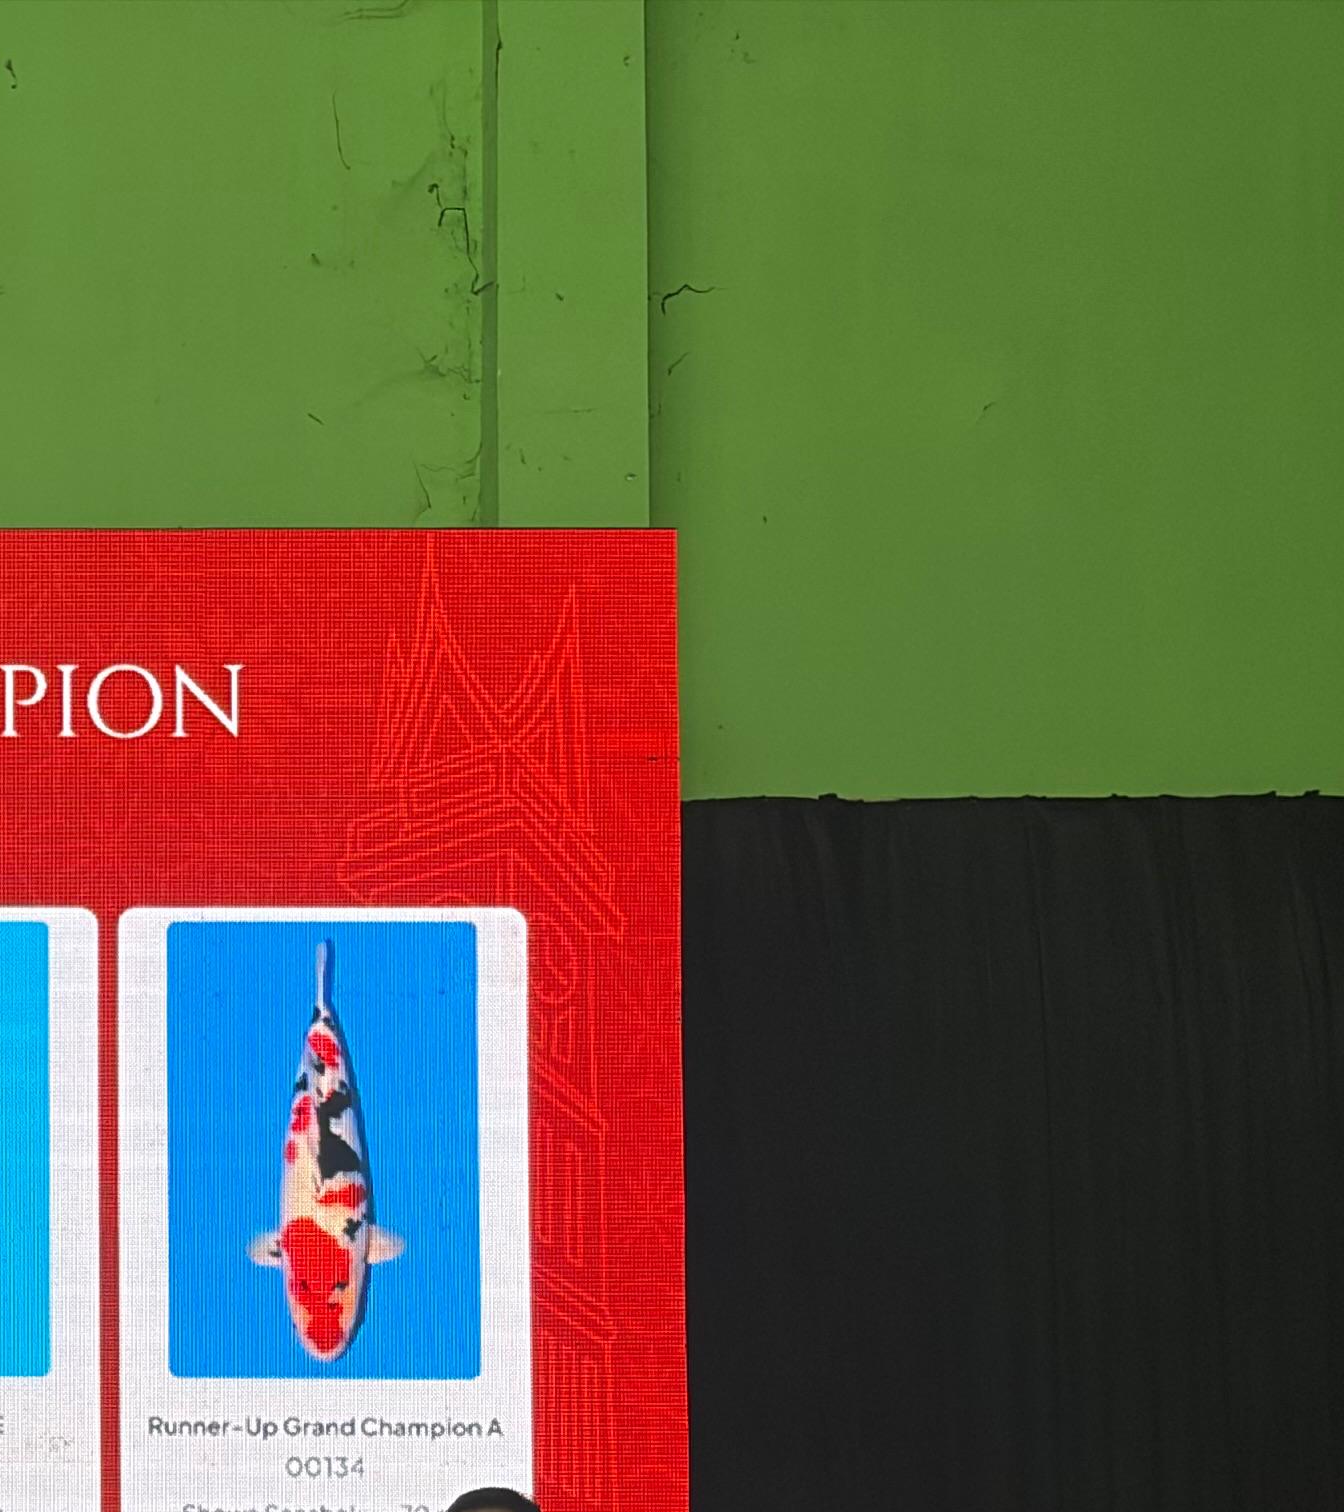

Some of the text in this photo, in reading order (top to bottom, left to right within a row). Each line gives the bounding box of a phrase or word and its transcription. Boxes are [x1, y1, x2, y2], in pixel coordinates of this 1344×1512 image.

[148, 1417, 503, 1440] Runner-Up Grand Champion A
[285, 1457, 365, 1478] 00134
